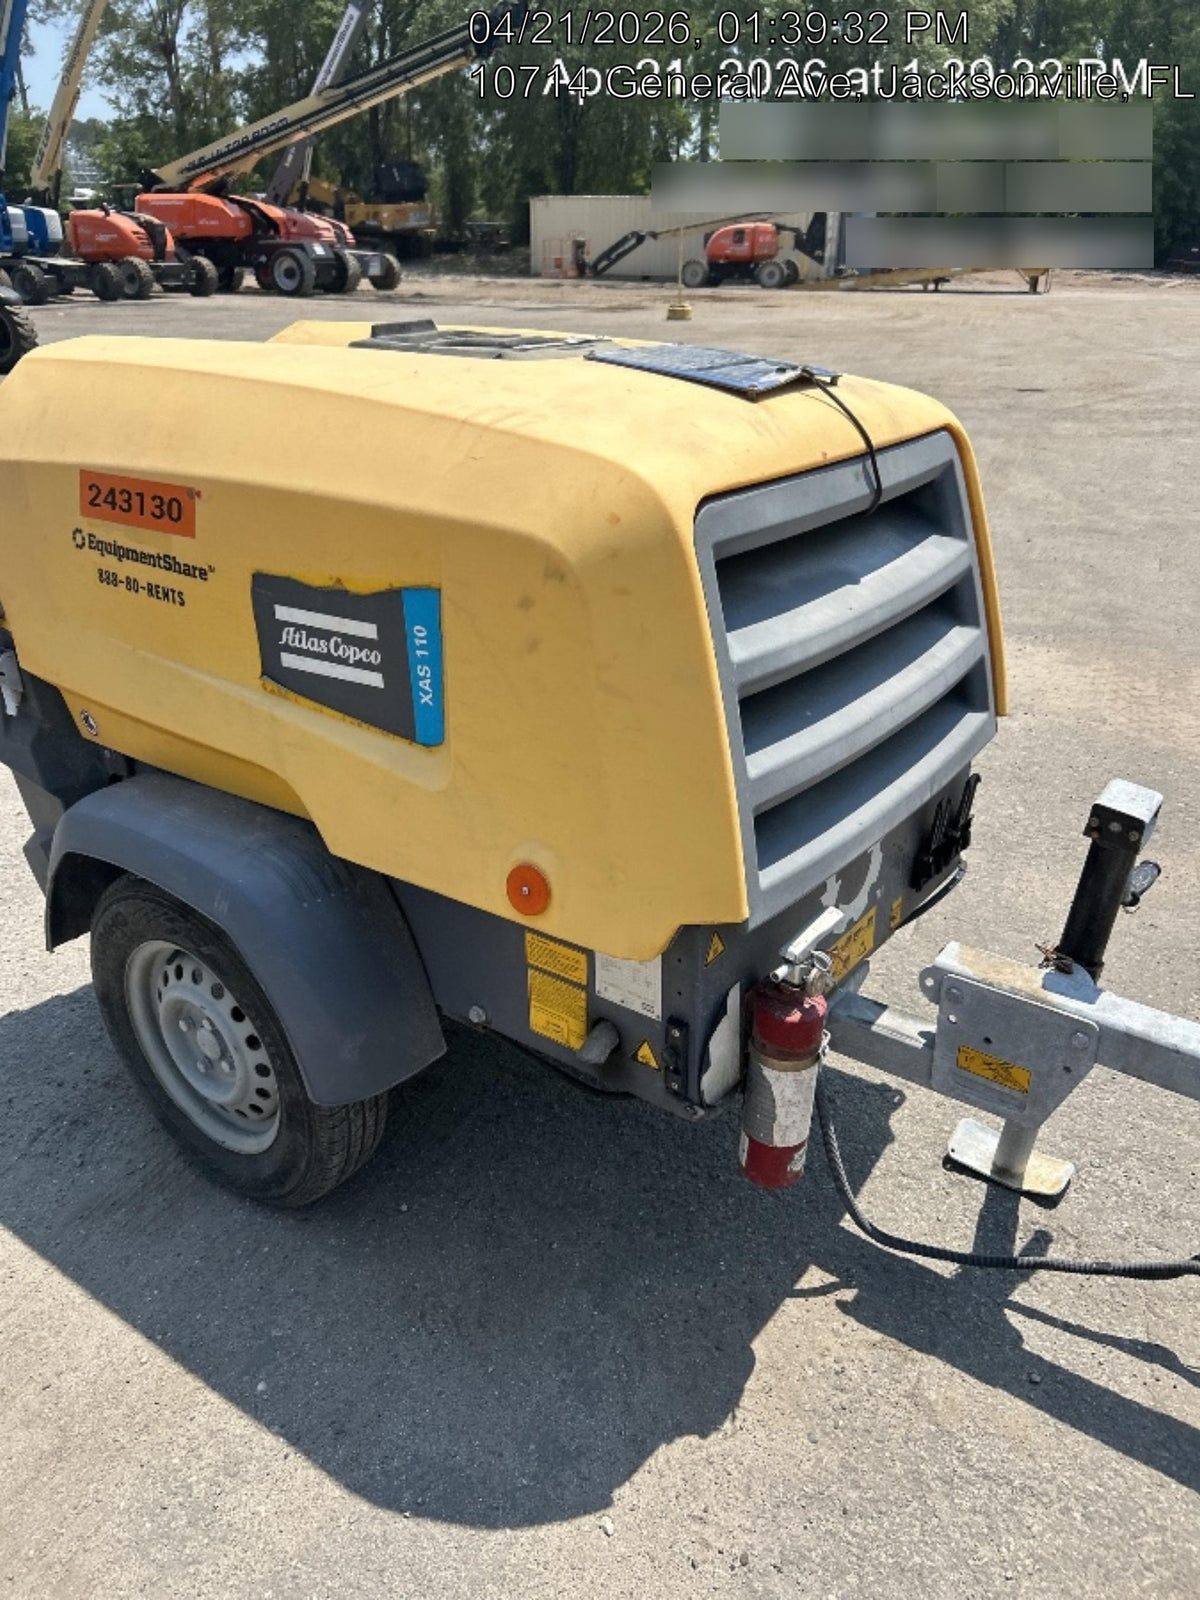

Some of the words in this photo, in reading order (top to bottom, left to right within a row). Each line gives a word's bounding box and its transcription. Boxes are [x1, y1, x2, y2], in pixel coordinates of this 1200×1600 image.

[88, 483, 182, 523] 243130
[87, 533, 209, 581] EquipmentShare
[97, 568, 185, 607] 888-80-RENTS
[278, 627, 328, 654] Atlas
[329, 636, 381, 665] Copco
[413, 625, 428, 657] 110
[416, 665, 433, 706] XAS
